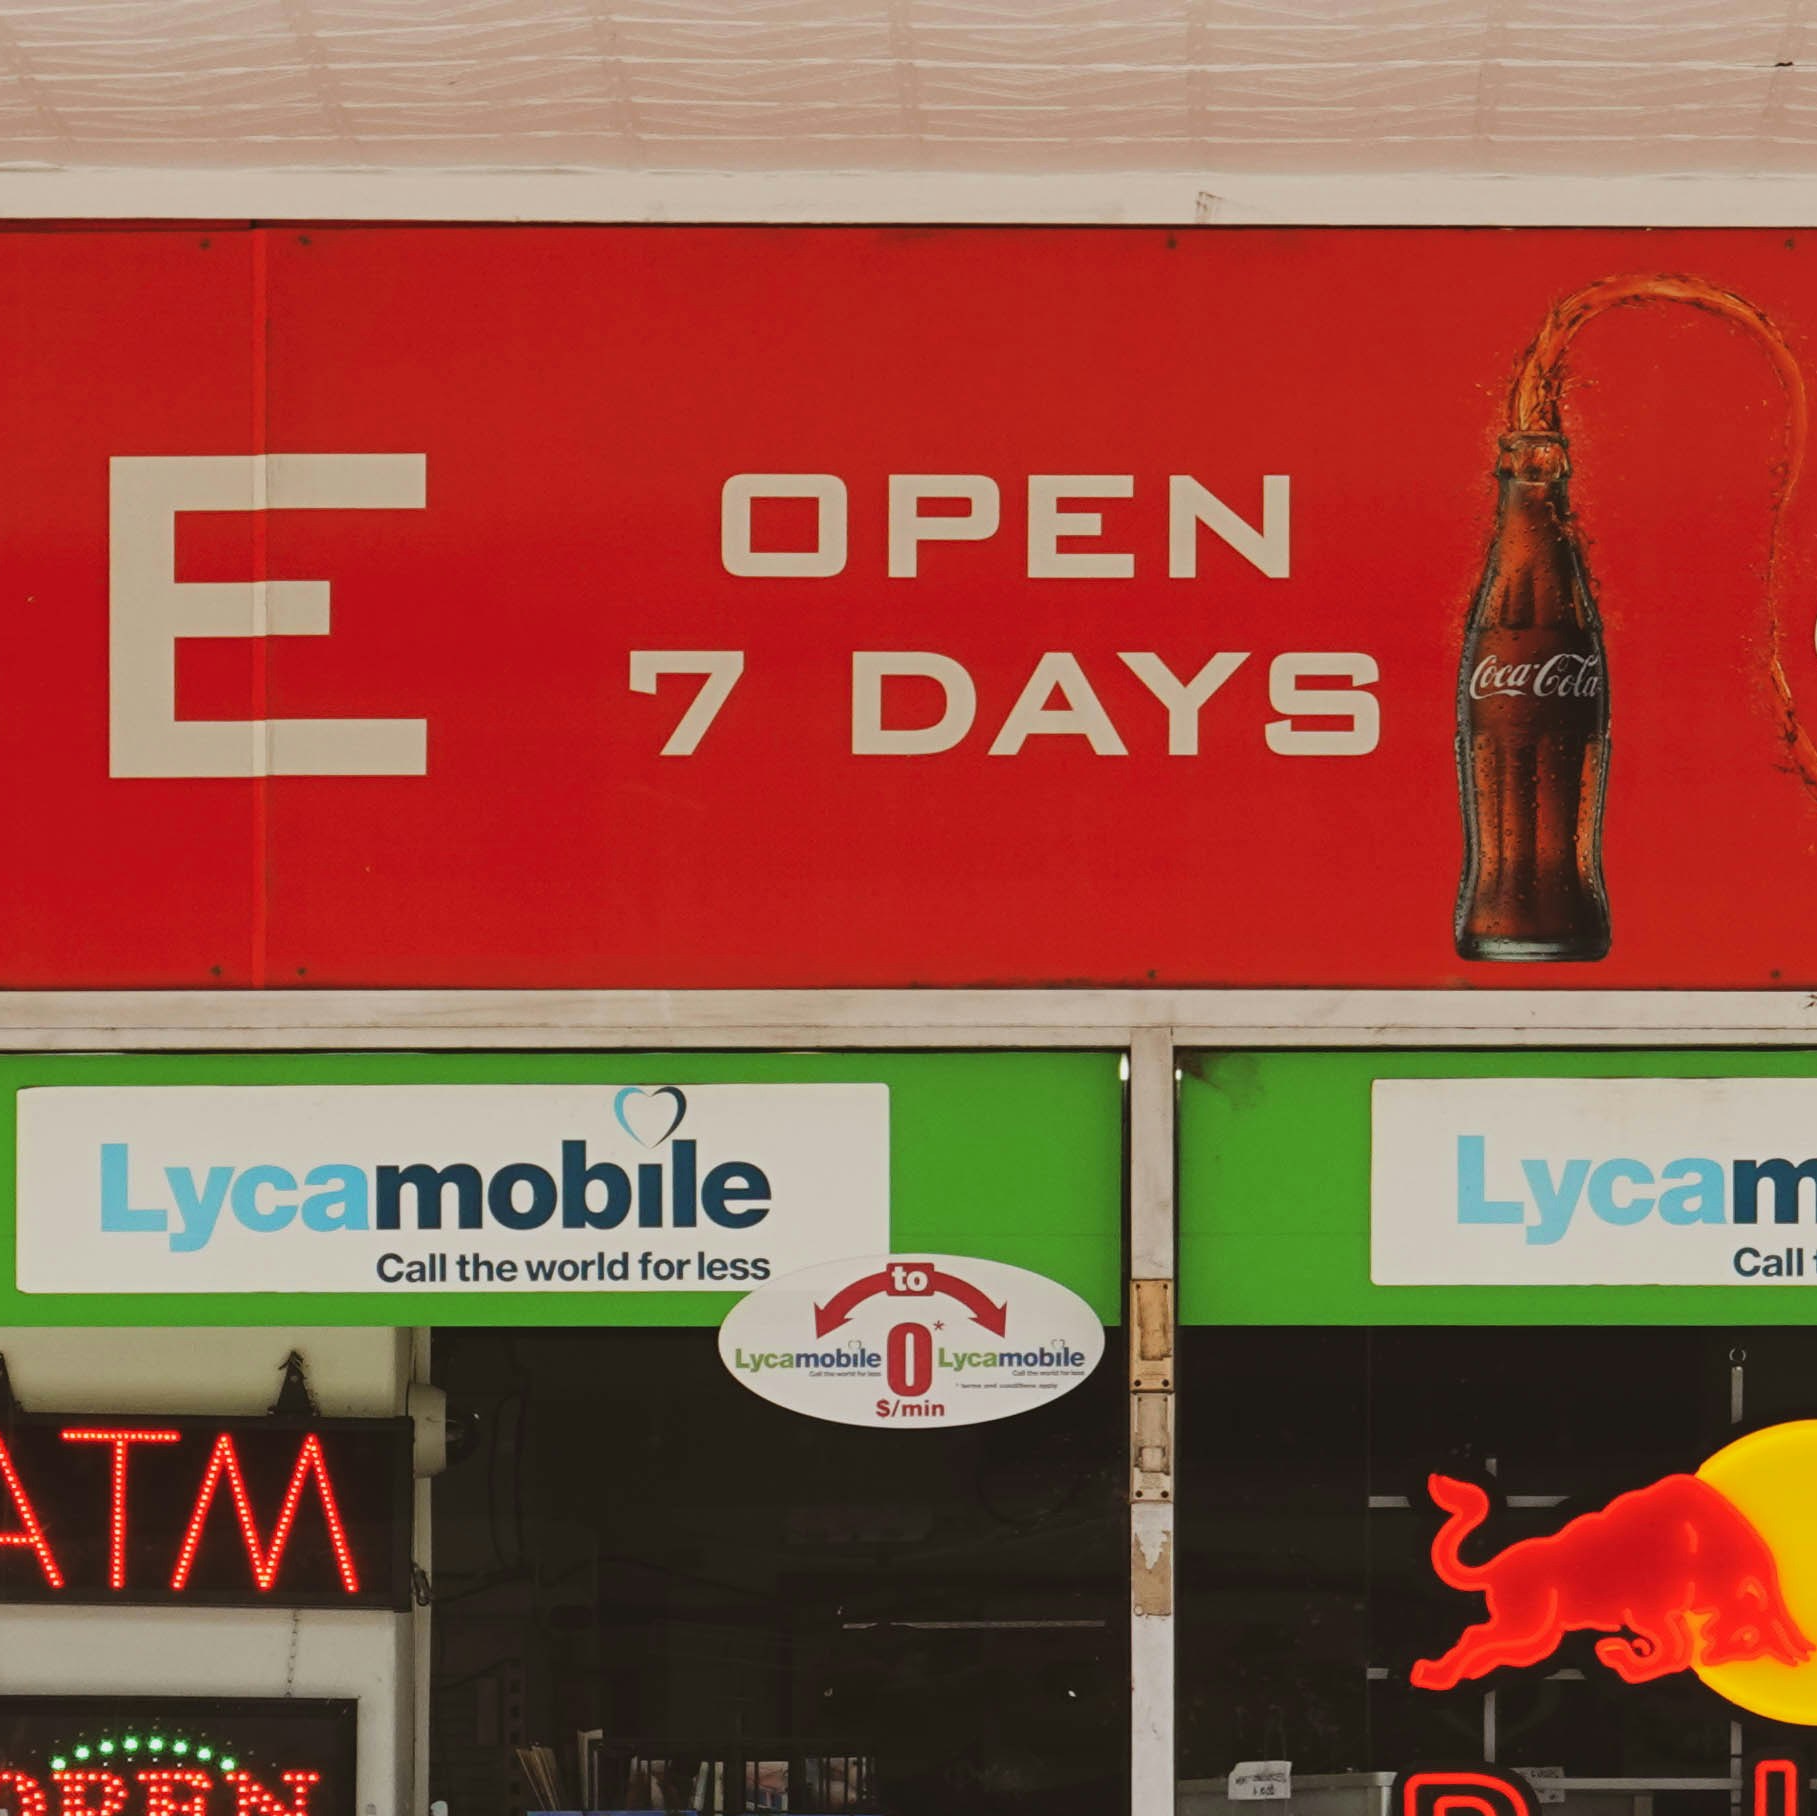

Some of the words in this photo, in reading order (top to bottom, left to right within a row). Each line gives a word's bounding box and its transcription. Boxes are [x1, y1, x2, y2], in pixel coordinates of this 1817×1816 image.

[721, 472, 1291, 579] OPEN
[1468, 652, 1600, 701] Coca-Cola
[627, 649, 747, 757] 7
[849, 650, 1382, 758] DAYS
[97, 1138, 772, 1253] Lycamobile
[375, 1251, 451, 1284] Call
[456, 1251, 519, 1284] the
[525, 1251, 629, 1284] world
[637, 1251, 693, 1284] for
[697, 1251, 771, 1284] less
[892, 1266, 928, 1292] to
[1731, 1246, 1807, 1279] Call
[735, 1347, 882, 1373] Lycamobile
[938, 1346, 1085, 1372] Lycamobile
[875, 1400, 945, 1418] $/min
